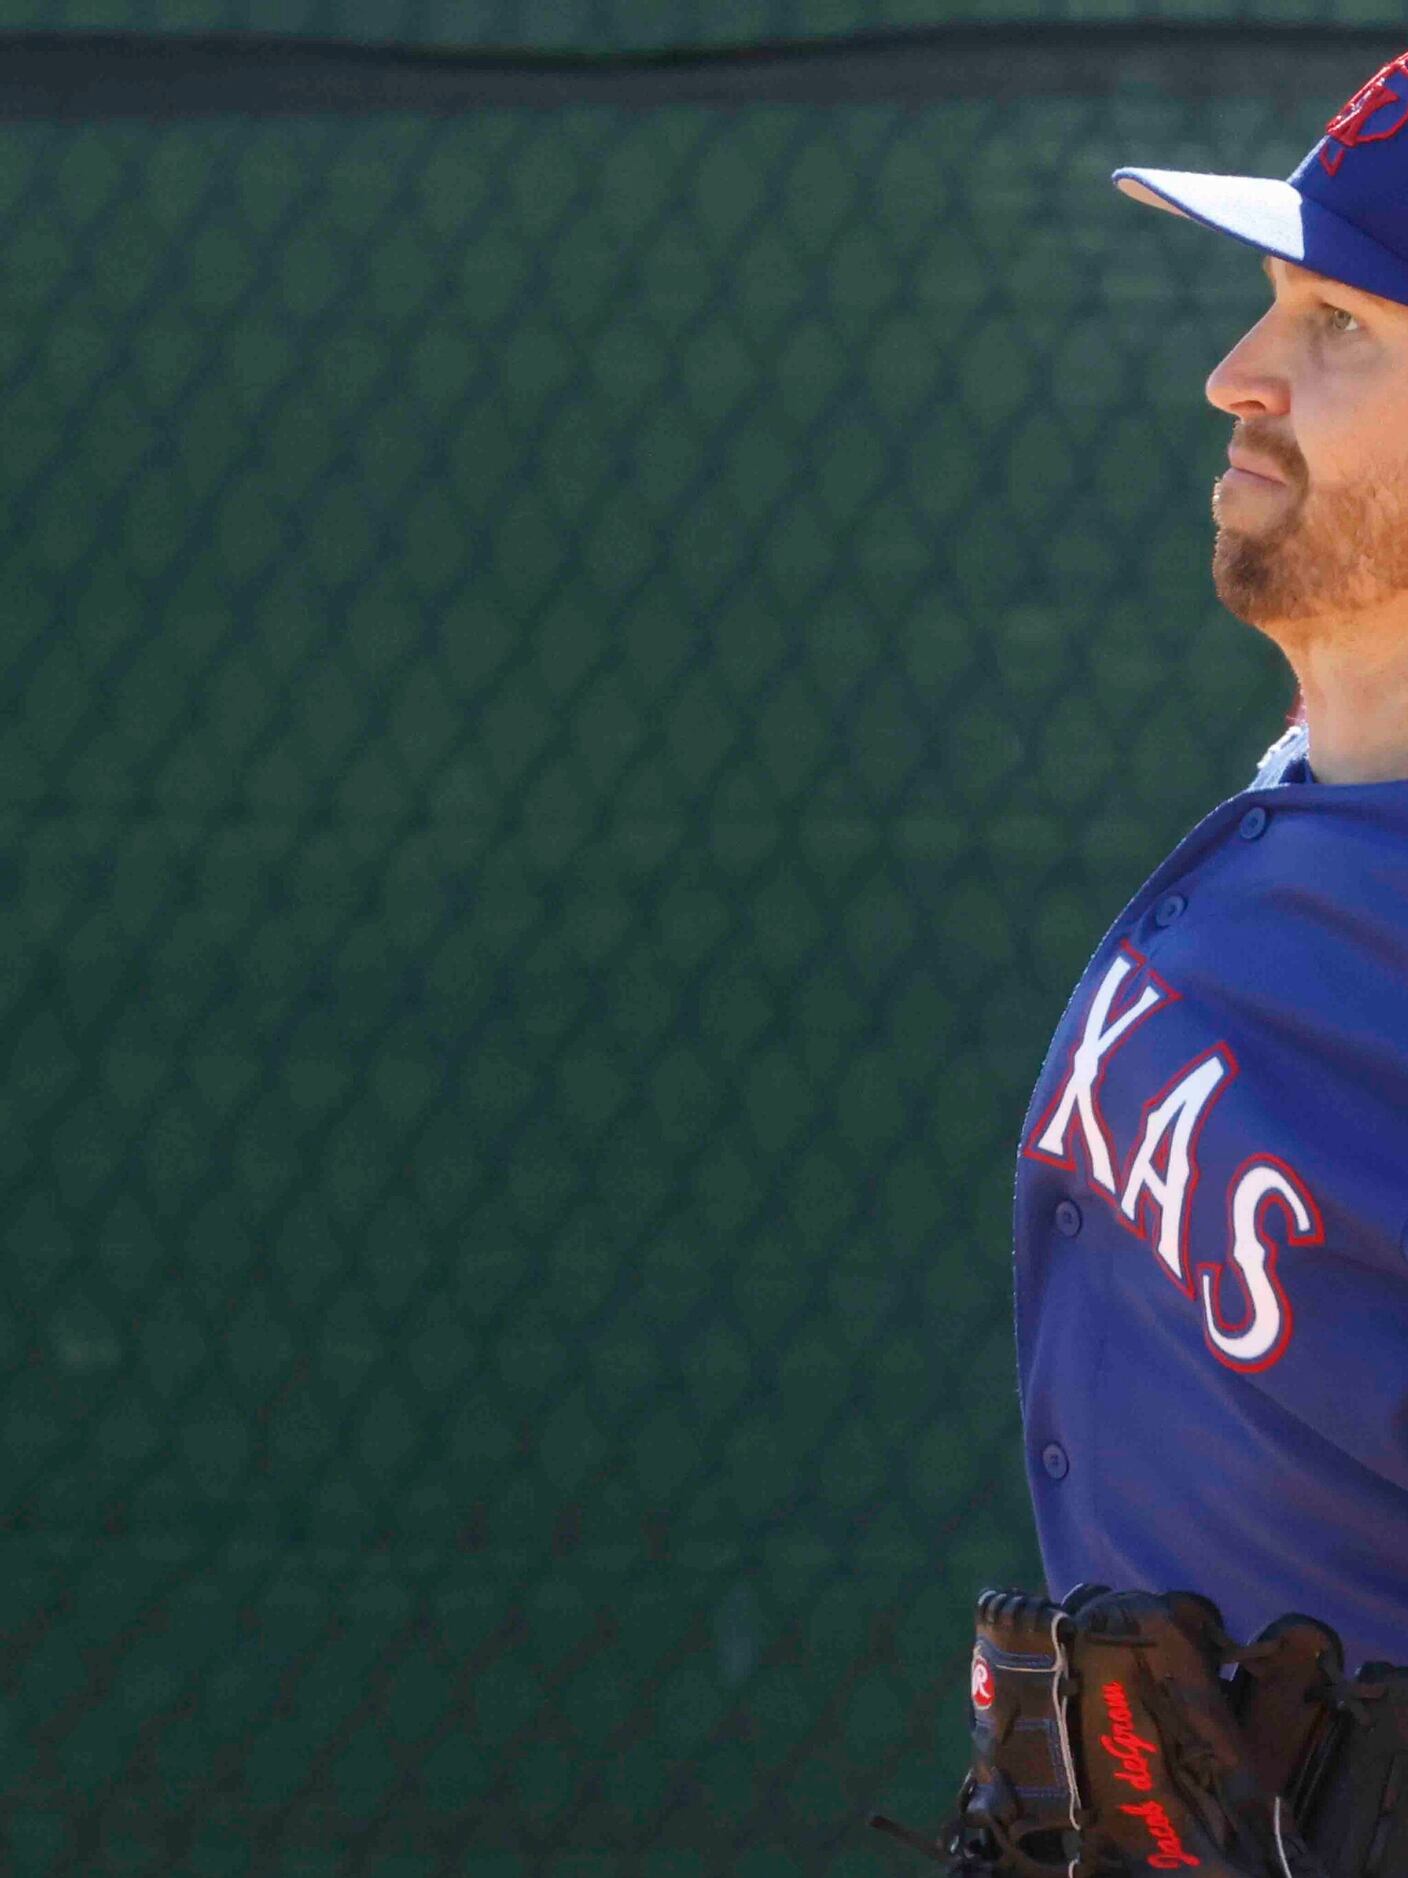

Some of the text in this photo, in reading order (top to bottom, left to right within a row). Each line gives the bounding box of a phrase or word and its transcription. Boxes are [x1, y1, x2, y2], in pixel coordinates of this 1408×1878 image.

[1021, 938, 1325, 1374] XAS
[971, 1663, 991, 1699] R
[1100, 1680, 1200, 1869] Jacob deGrom
